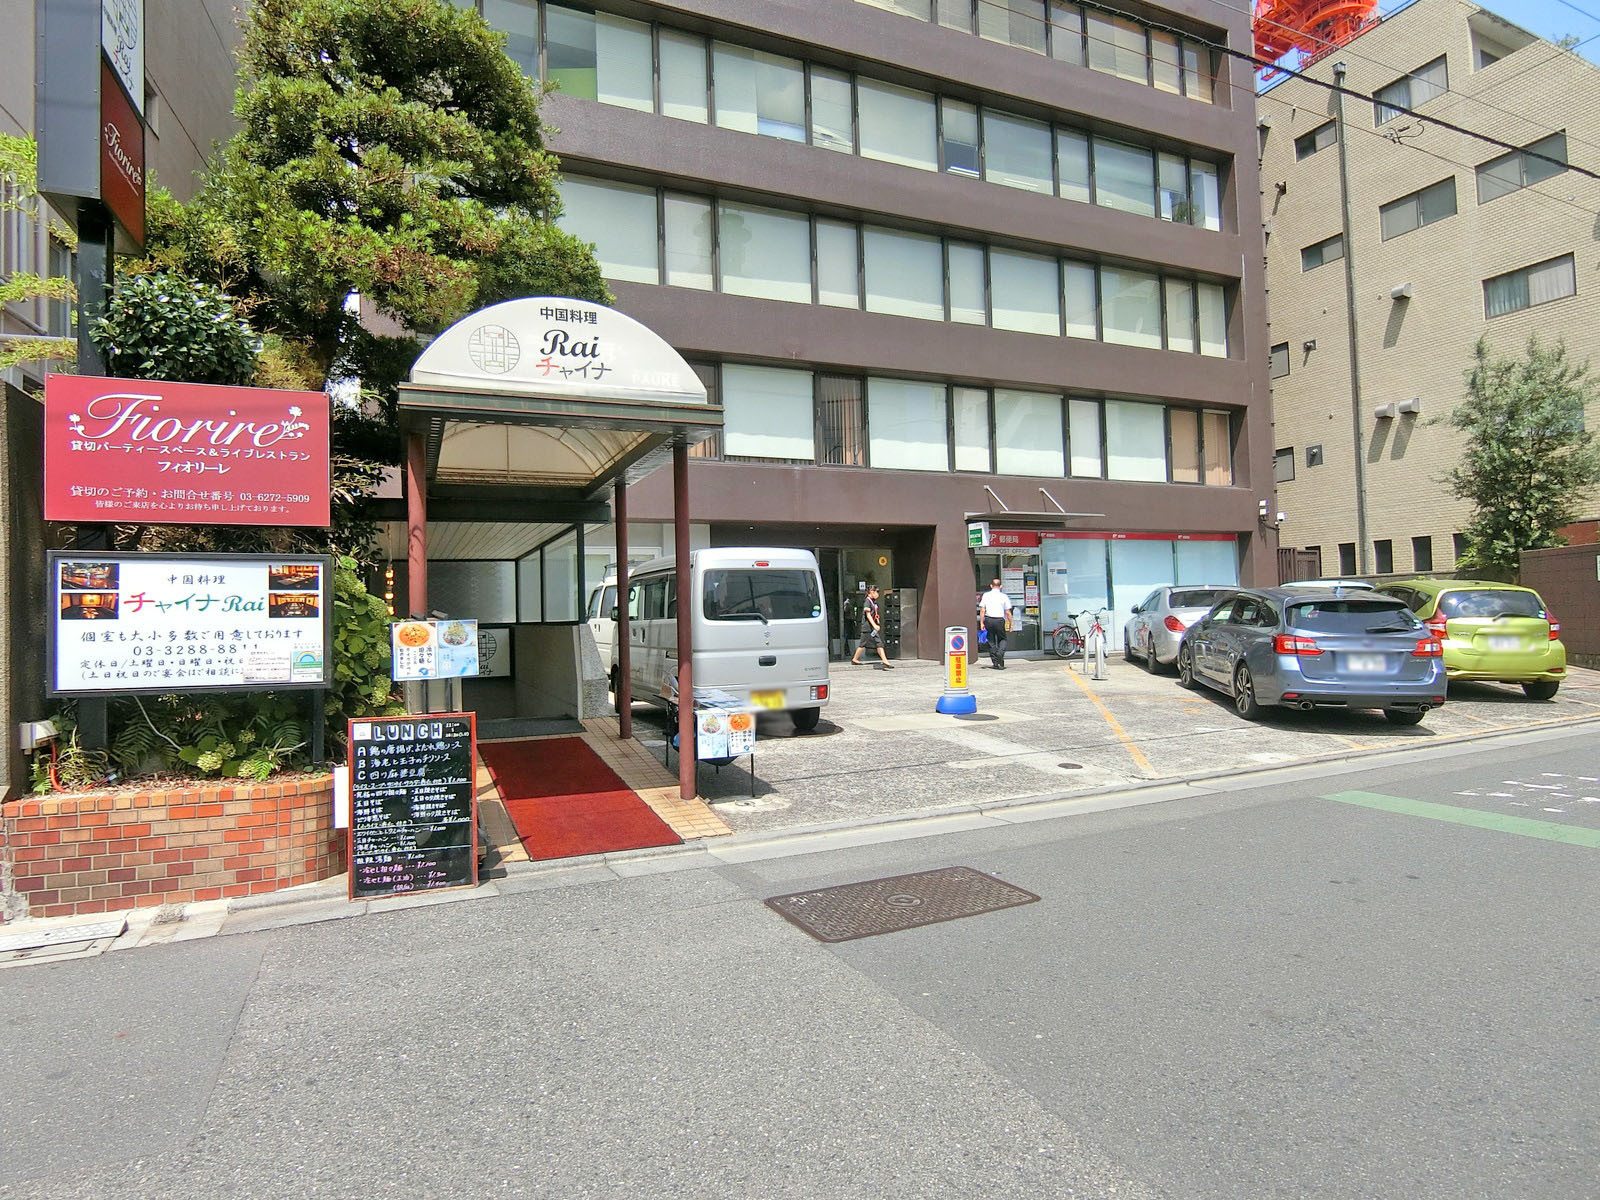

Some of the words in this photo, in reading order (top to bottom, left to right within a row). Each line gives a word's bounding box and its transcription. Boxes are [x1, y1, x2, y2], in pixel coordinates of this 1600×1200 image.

[104, 122, 142, 186] Fiorire
[539, 306, 598, 325] 中国料理
[539, 329, 601, 359] Rai
[535, 356, 613, 381] チャイナ
[80, 393, 282, 448] Fiorire
[157, 460, 232, 474] フィオリーレ
[239, 492, 311, 503] 03-6272-5909
[167, 574, 227, 585] 中国料理
[123, 591, 220, 614] チャイナ
[222, 594, 266, 613] Rai
[373, 722, 443, 741] LUNCH
[357, 746, 367, 757] A
[358, 759, 366, 769] B
[357, 770, 366, 780] C
